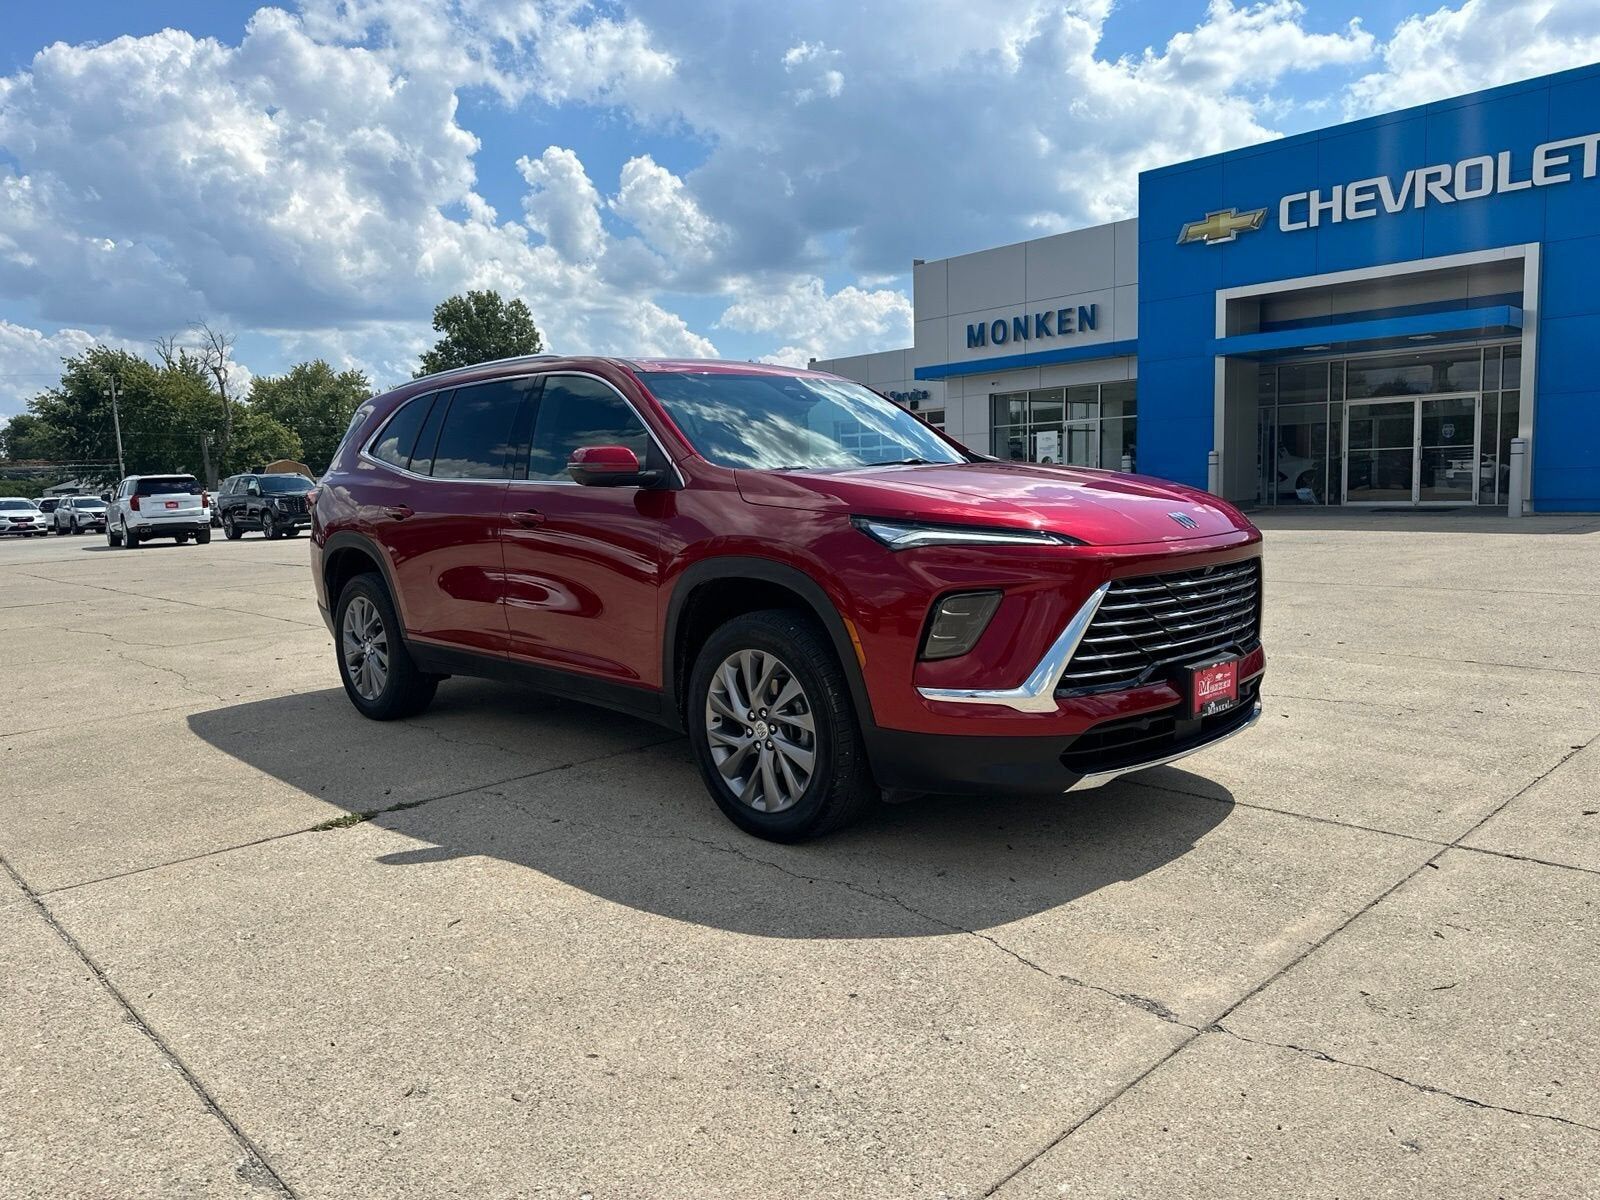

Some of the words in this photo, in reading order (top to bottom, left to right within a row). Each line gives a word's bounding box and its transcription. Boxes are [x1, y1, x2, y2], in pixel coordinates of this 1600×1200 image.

[1279, 132, 1600, 232] CHEVROLET
[967, 303, 1098, 349] MONKEN
[890, 389, 929, 401] Service
